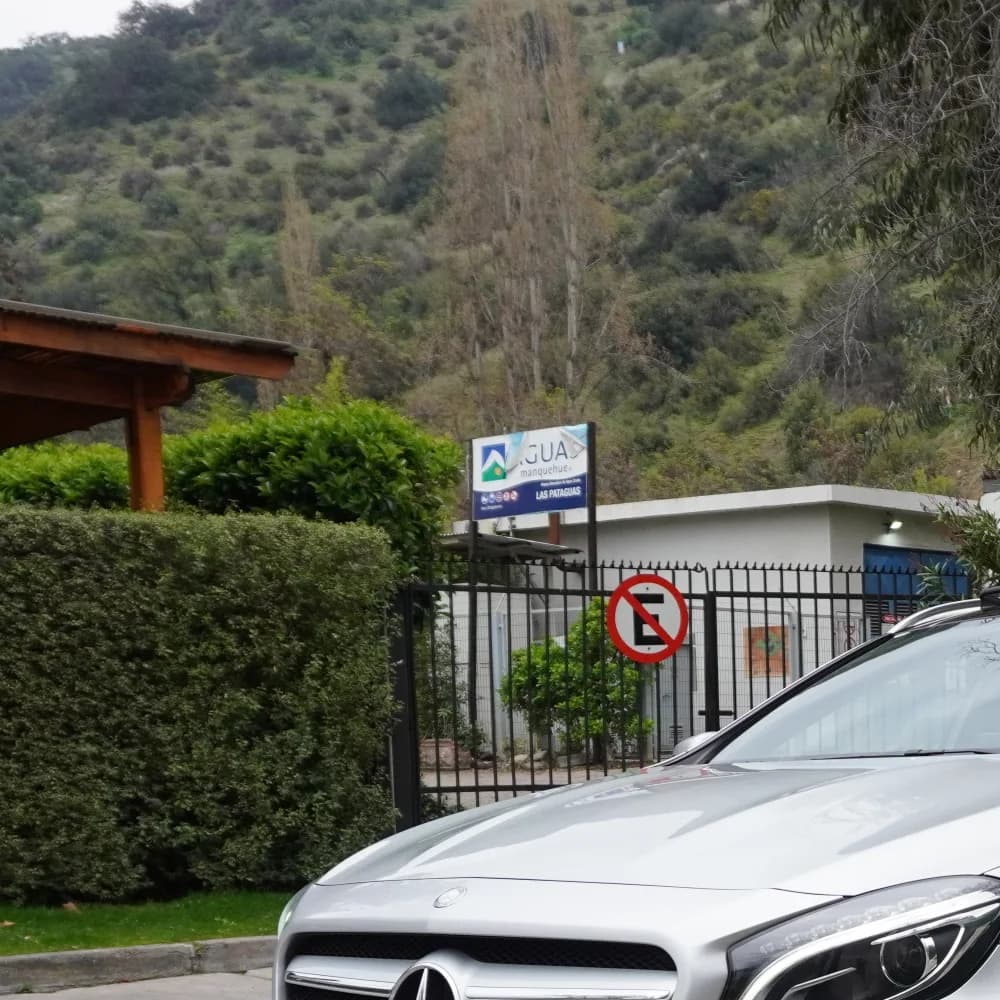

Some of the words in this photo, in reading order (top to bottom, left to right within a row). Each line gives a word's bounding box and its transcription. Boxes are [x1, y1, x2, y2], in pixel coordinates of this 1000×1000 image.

[519, 440, 578, 465] GUA
[520, 463, 568, 479] manquehue
[536, 489, 548, 500] LAS
[549, 486, 581, 498] PATAGUAS
[633, 594, 667, 645] E
